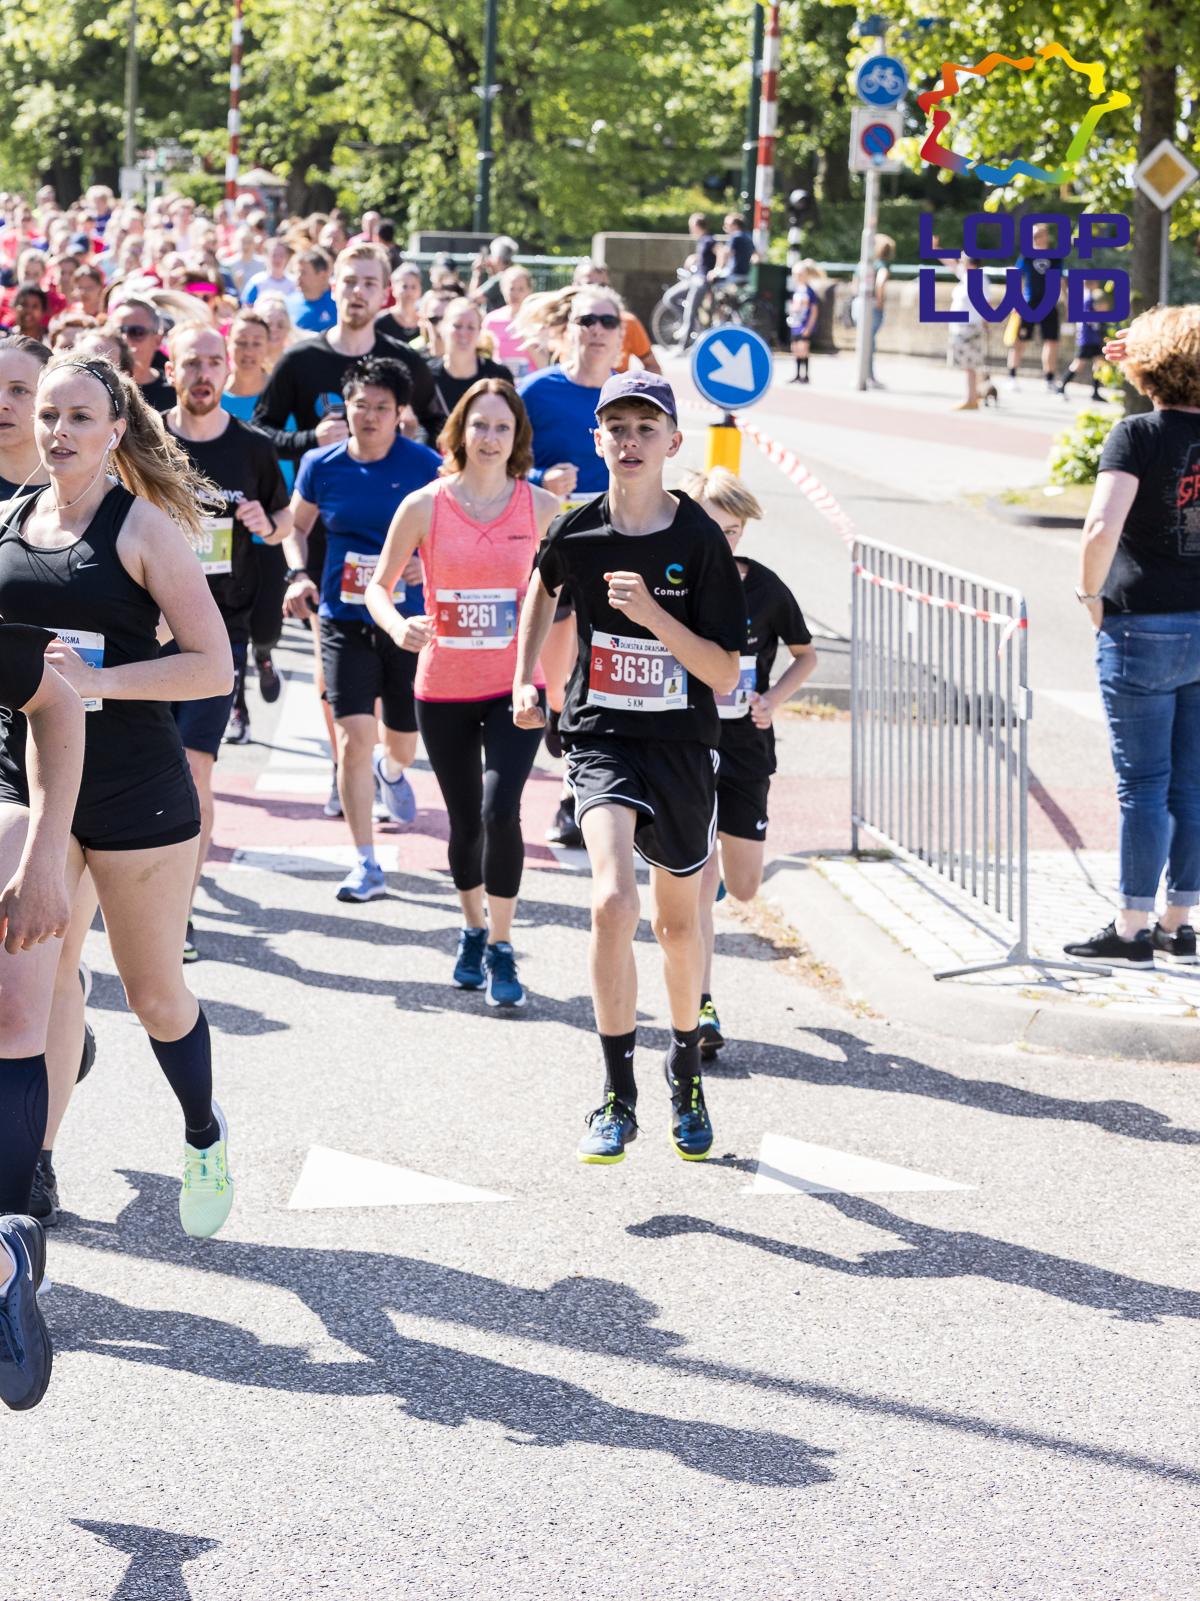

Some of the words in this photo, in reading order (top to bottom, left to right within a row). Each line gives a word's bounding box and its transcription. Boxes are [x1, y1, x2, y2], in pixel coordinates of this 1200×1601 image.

[457, 604, 497, 627] 3261
[610, 653, 664, 685] 3638
[627, 698, 634, 707] 5
[635, 699, 644, 708] KM
